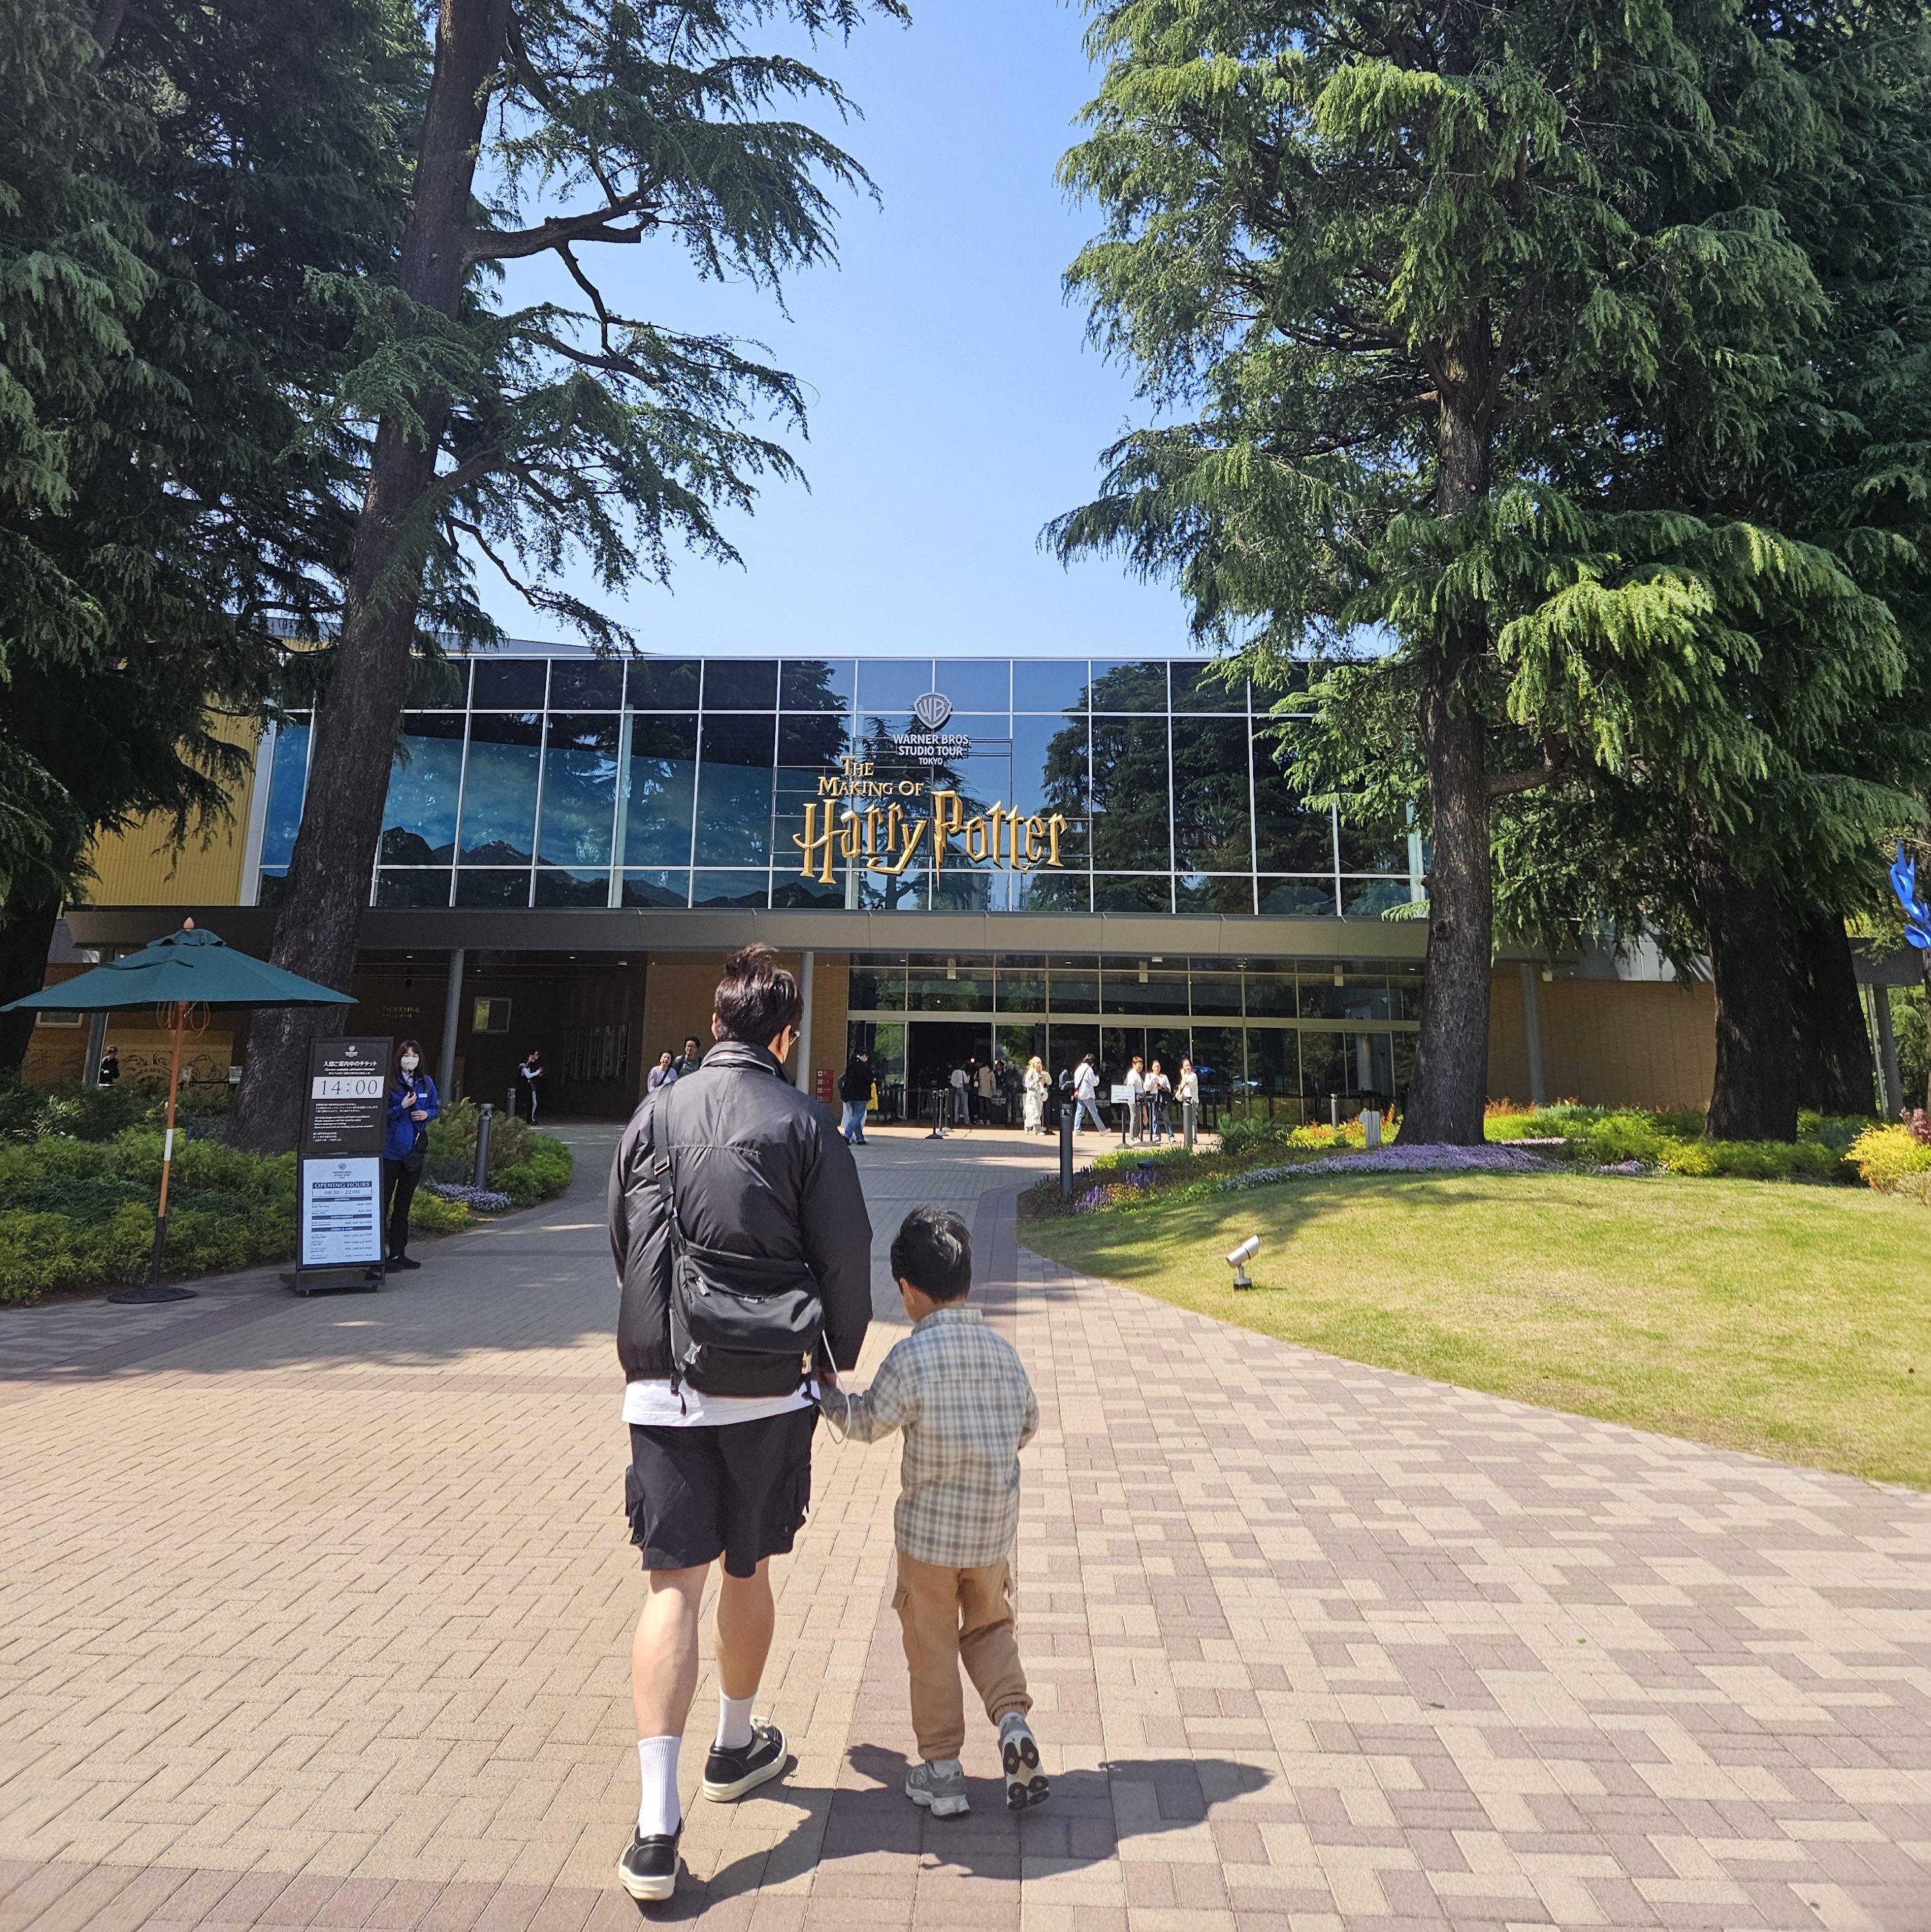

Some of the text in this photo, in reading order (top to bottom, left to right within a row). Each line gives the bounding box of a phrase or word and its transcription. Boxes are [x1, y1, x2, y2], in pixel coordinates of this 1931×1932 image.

[893, 734, 972, 745] WARNER BROS.
[898, 746, 963, 756] STUDIO TOUR
[793, 790, 1068, 891] Harry Potter
[321, 1079, 378, 1095] 14:00
